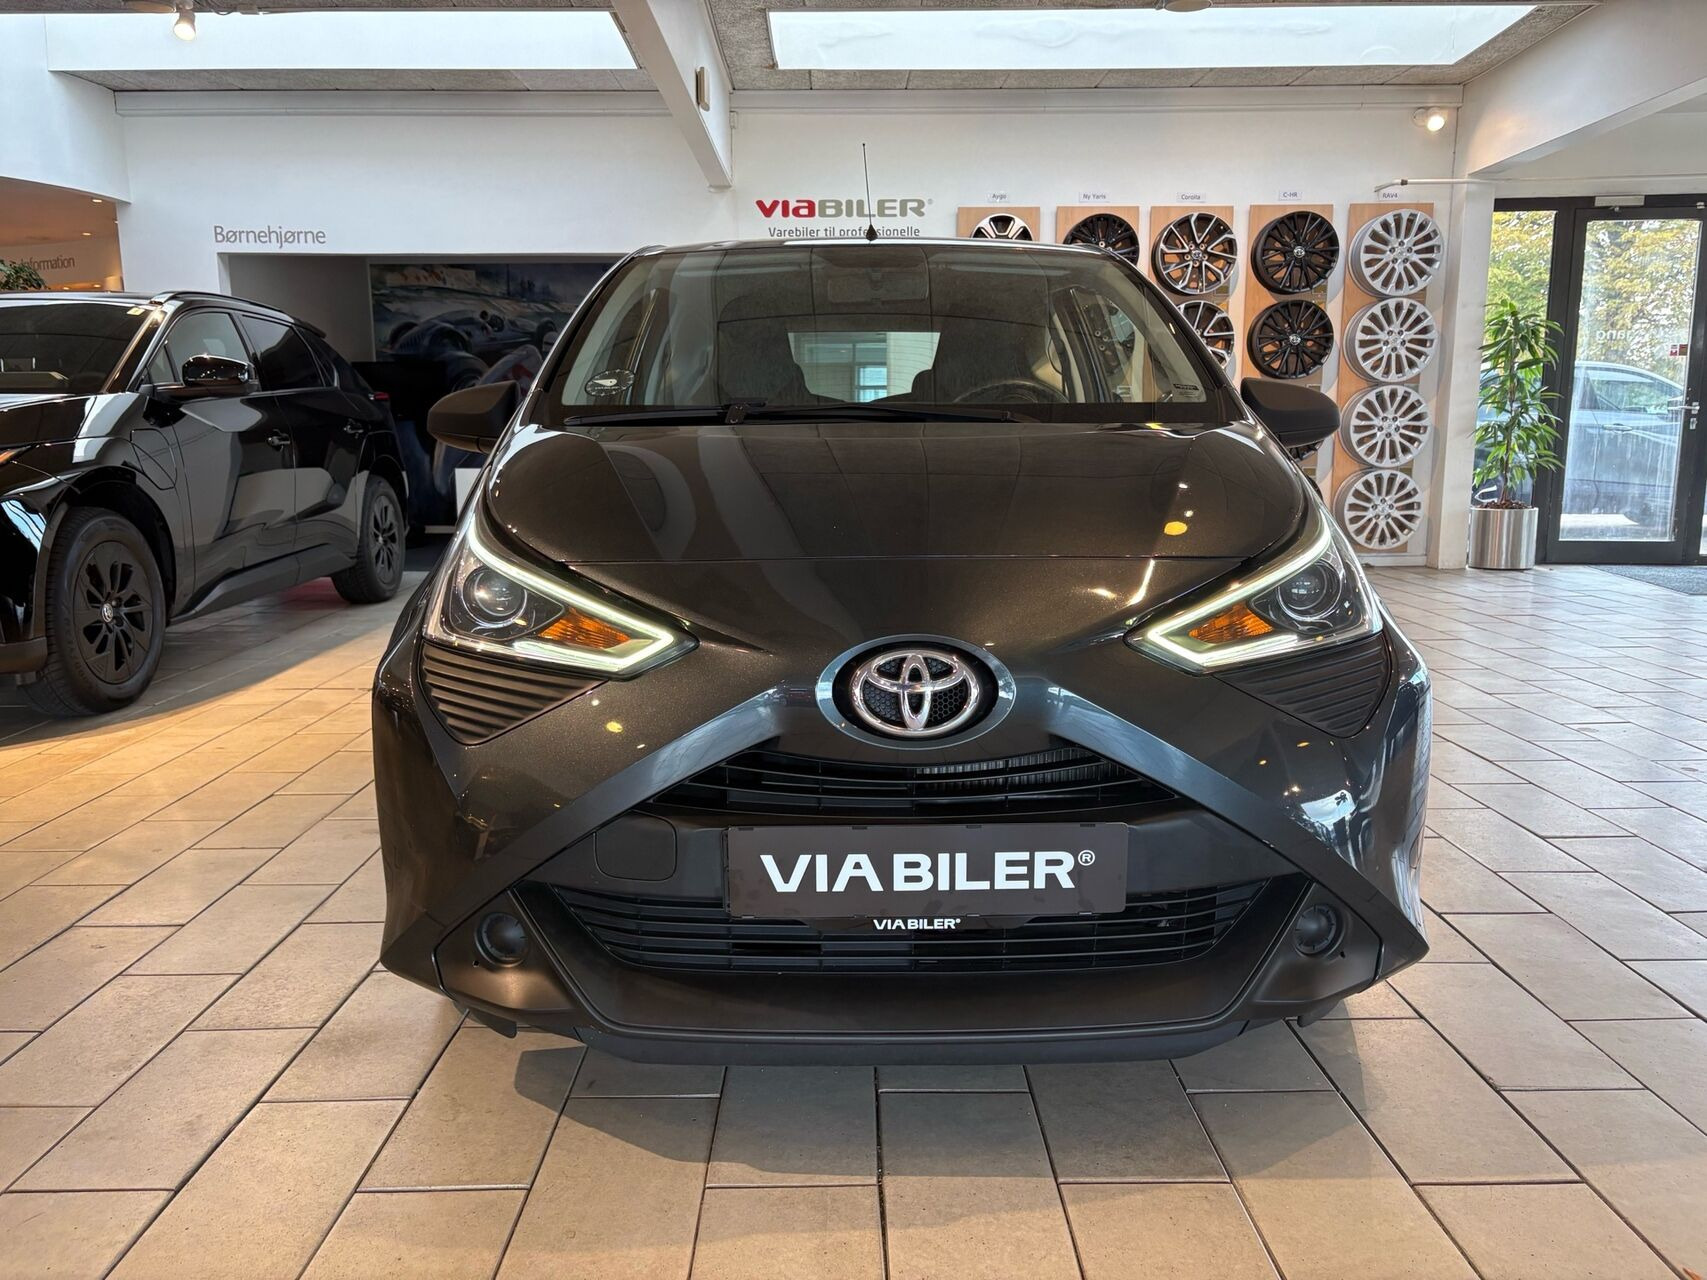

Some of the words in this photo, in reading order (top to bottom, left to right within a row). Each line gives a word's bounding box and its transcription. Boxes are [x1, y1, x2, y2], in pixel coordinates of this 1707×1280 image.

[213, 225, 326, 249] Børnehjørne
[768, 226, 820, 238] Varebiler
[824, 226, 836, 237] til
[839, 225, 921, 237] profesionelle
[760, 853, 884, 893] VIA
[873, 919, 906, 930] VIA
